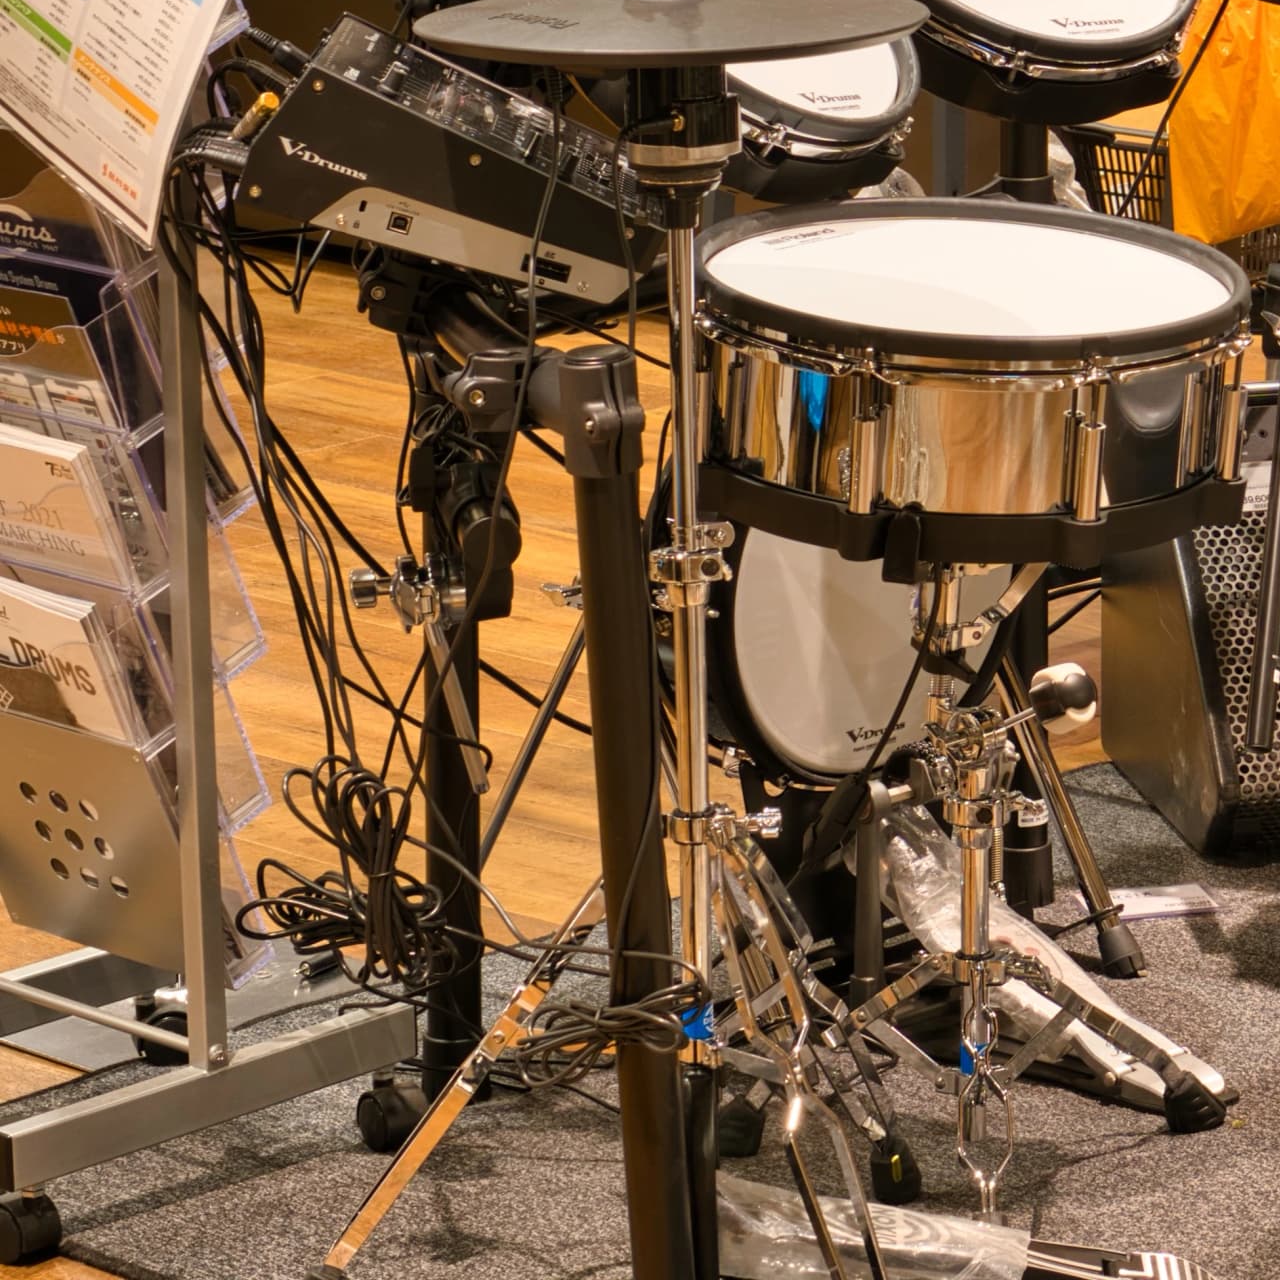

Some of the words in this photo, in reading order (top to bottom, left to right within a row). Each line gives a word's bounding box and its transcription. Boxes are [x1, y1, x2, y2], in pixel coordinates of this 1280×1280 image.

[1050, 17, 1125, 29] V-Drums
[800, 92, 861, 104] V-Drums
[278, 135, 368, 181] V-Drums
[778, 227, 836, 242] Roland
[17, 500, 65, 531] 2021
[9, 636, 97, 697] DRUMS
